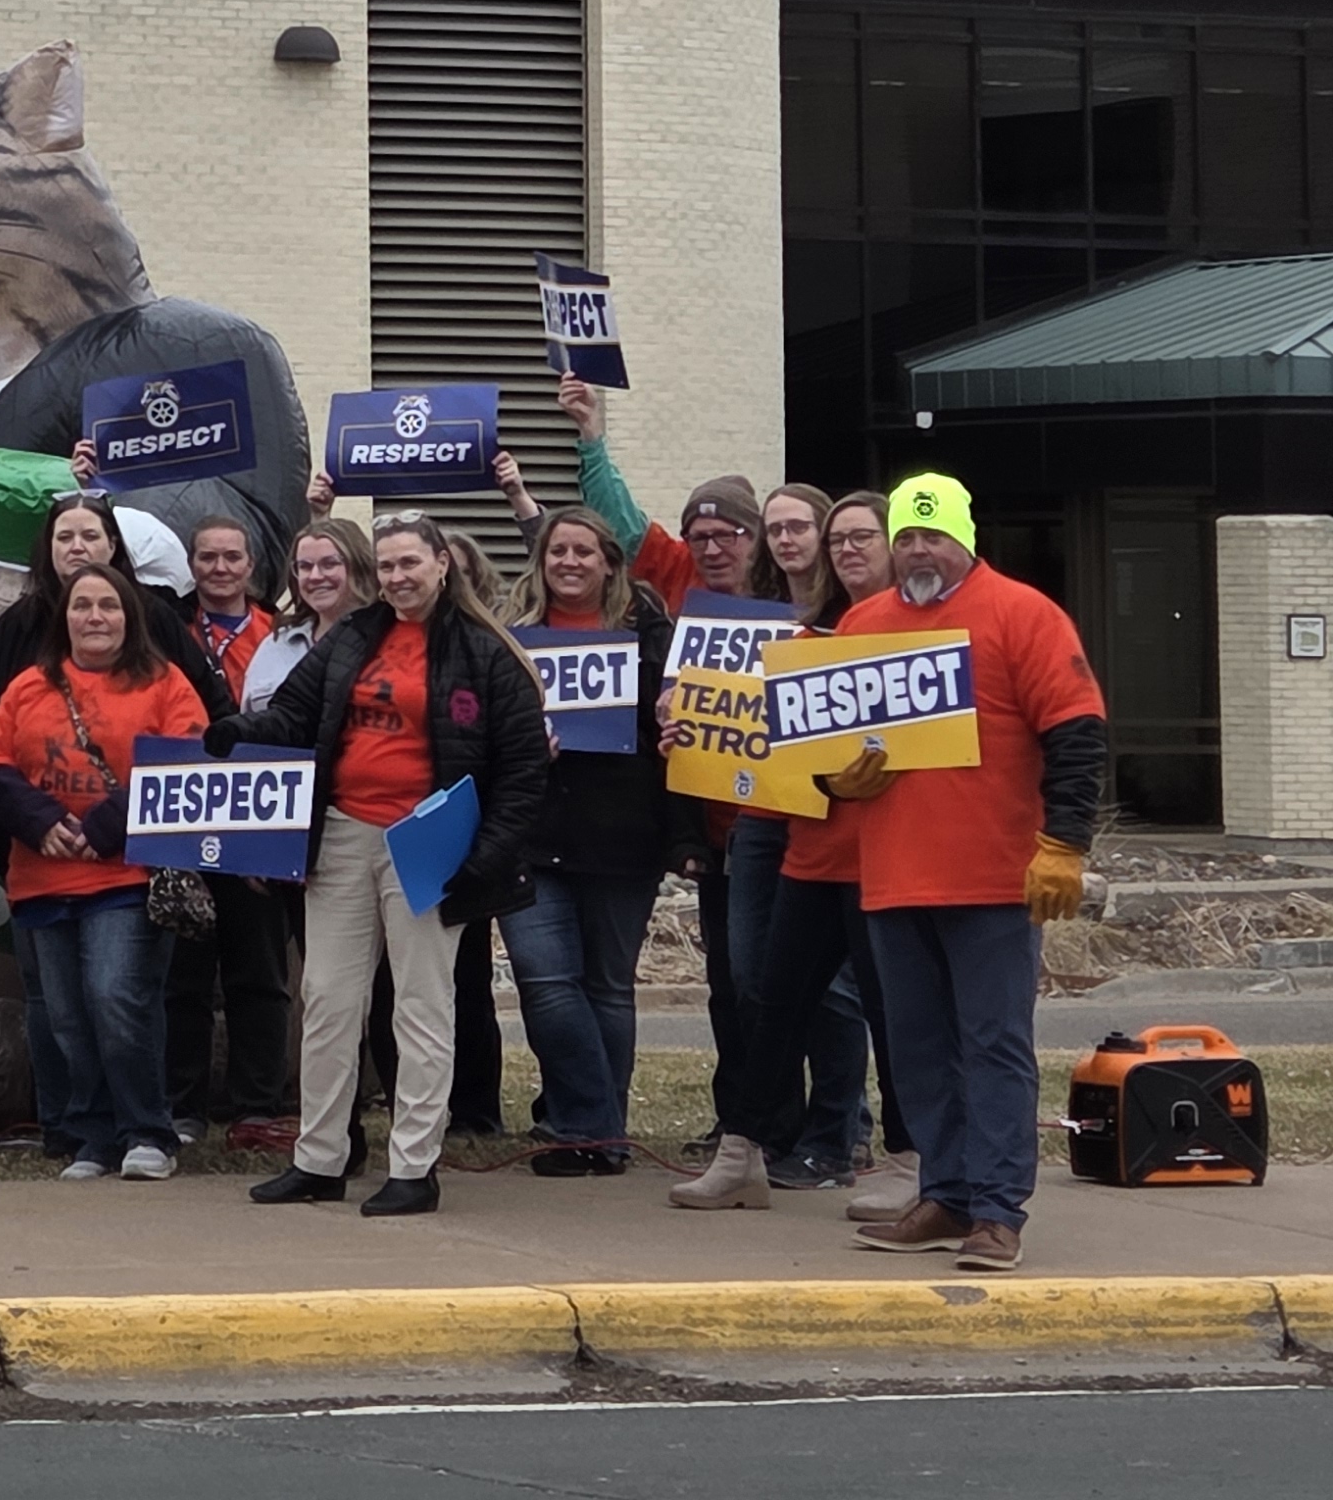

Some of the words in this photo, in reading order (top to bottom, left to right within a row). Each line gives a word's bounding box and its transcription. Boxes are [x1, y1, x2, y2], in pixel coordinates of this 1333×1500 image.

[107, 422, 226, 460] RESPECT
[350, 442, 473, 464] RESPECT
[680, 682, 768, 723] TEAM
[776, 652, 961, 736] RESPECT
[139, 771, 303, 825] RESPECT
